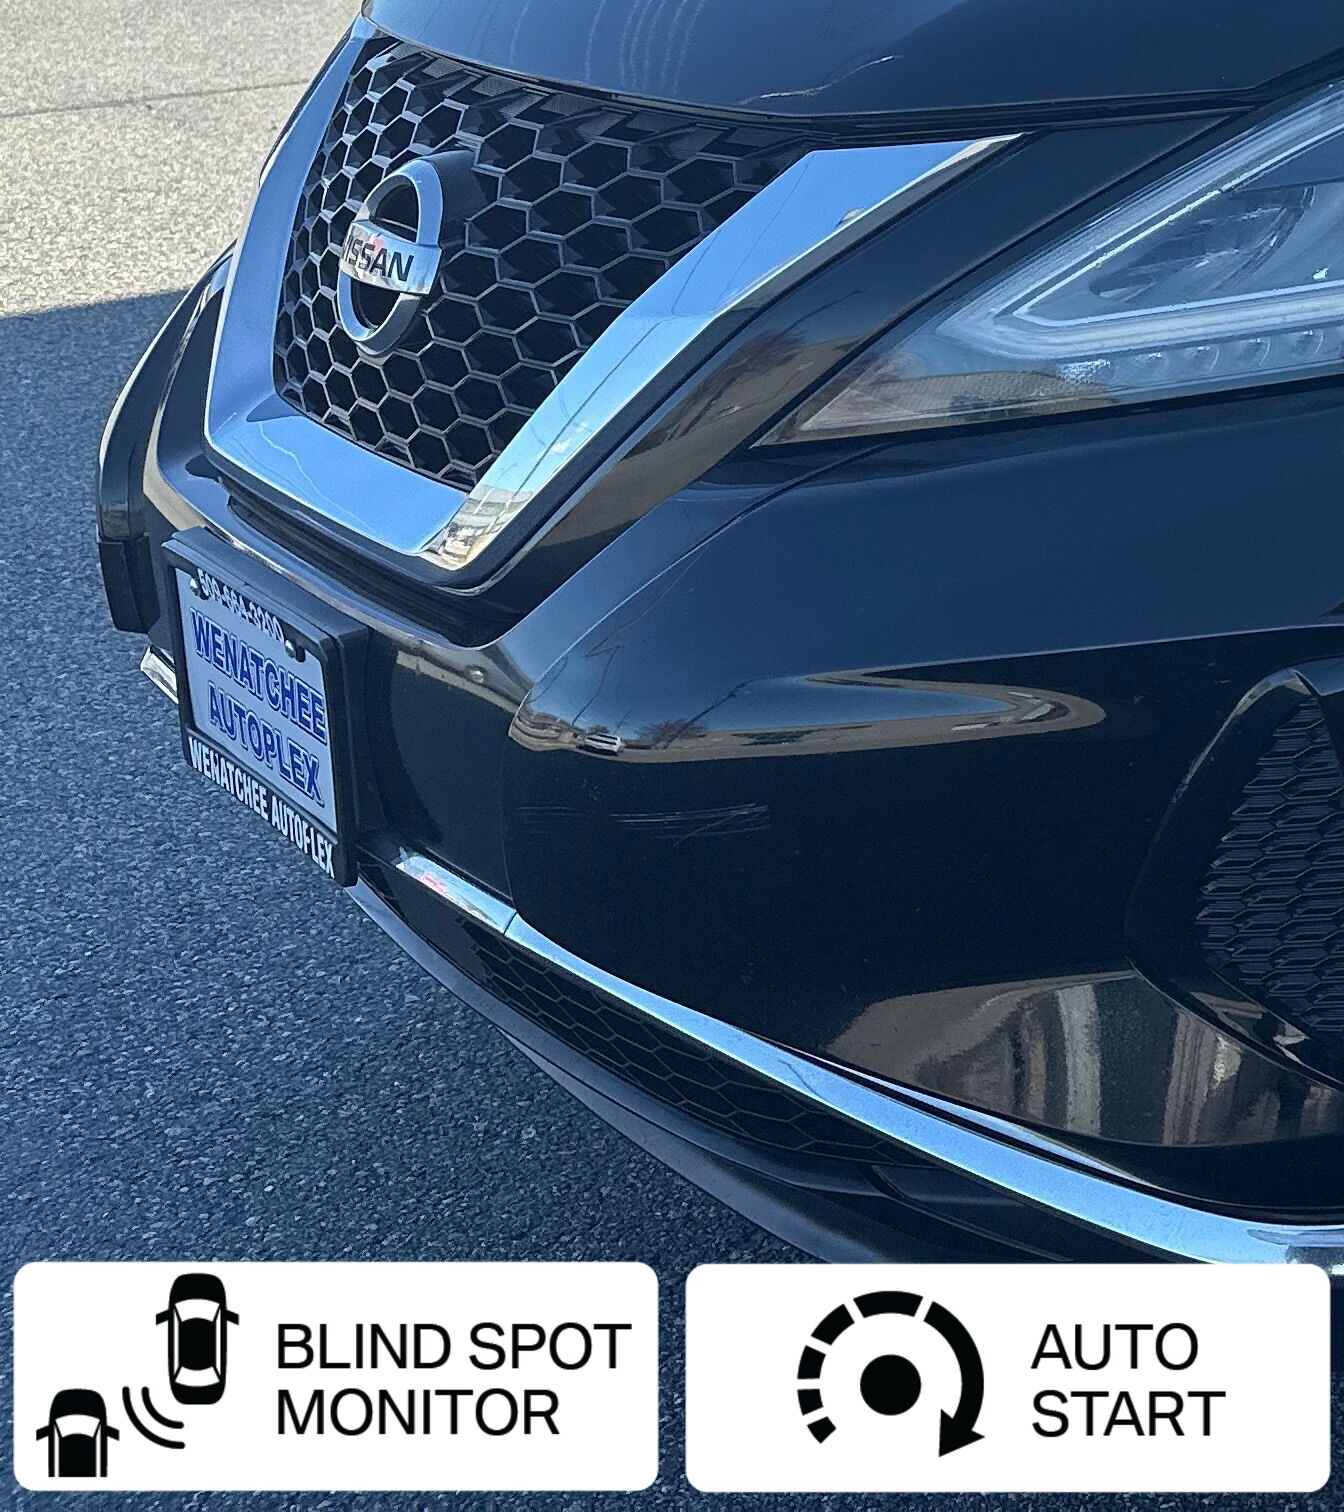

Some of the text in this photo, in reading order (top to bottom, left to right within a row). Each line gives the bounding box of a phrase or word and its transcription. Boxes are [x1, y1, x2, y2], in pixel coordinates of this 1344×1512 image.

[190, 608, 327, 745] WENATCHEE
[188, 737, 269, 821] WENATCHEE
[208, 681, 325, 808] AUTOPLEX
